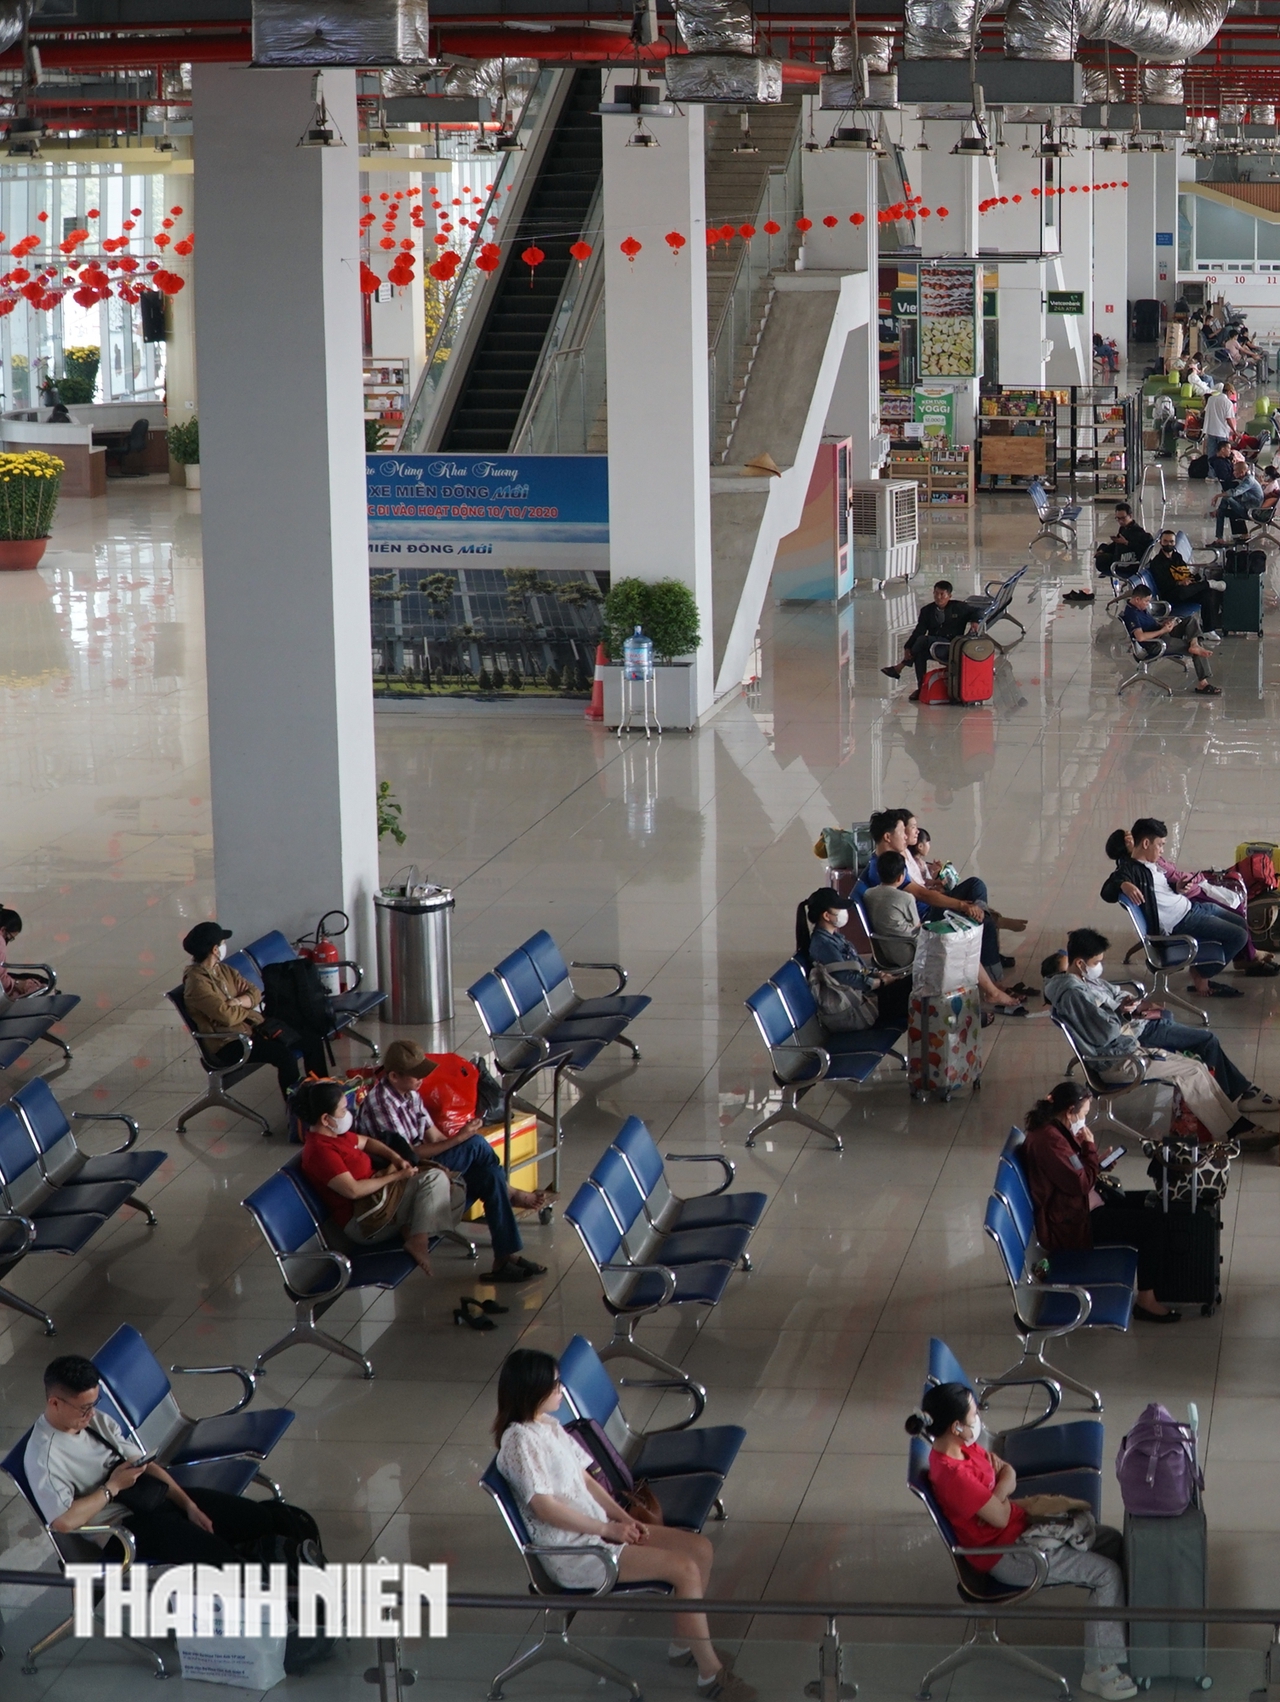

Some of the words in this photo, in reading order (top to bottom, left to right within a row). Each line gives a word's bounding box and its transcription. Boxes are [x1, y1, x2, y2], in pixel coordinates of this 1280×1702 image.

[1205, 276, 1217, 284] 09
[1235, 276, 1246, 284] 10
[1267, 276, 1277, 284] 11
[918, 405, 951, 413] YOGGI
[428, 460, 468, 479] Khai
[369, 485, 391, 498] XE
[396, 481, 437, 499] MIỀN
[442, 484, 489, 499] ĐÔNG
[378, 505, 390, 517] ĐI
[393, 502, 416, 517] VÀO
[418, 505, 450, 519] HOẠT
[452, 503, 485, 519] ĐỘNG
[487, 507, 559, 519] 10/10/2020
[407, 544, 454, 553] ĐÔNG
